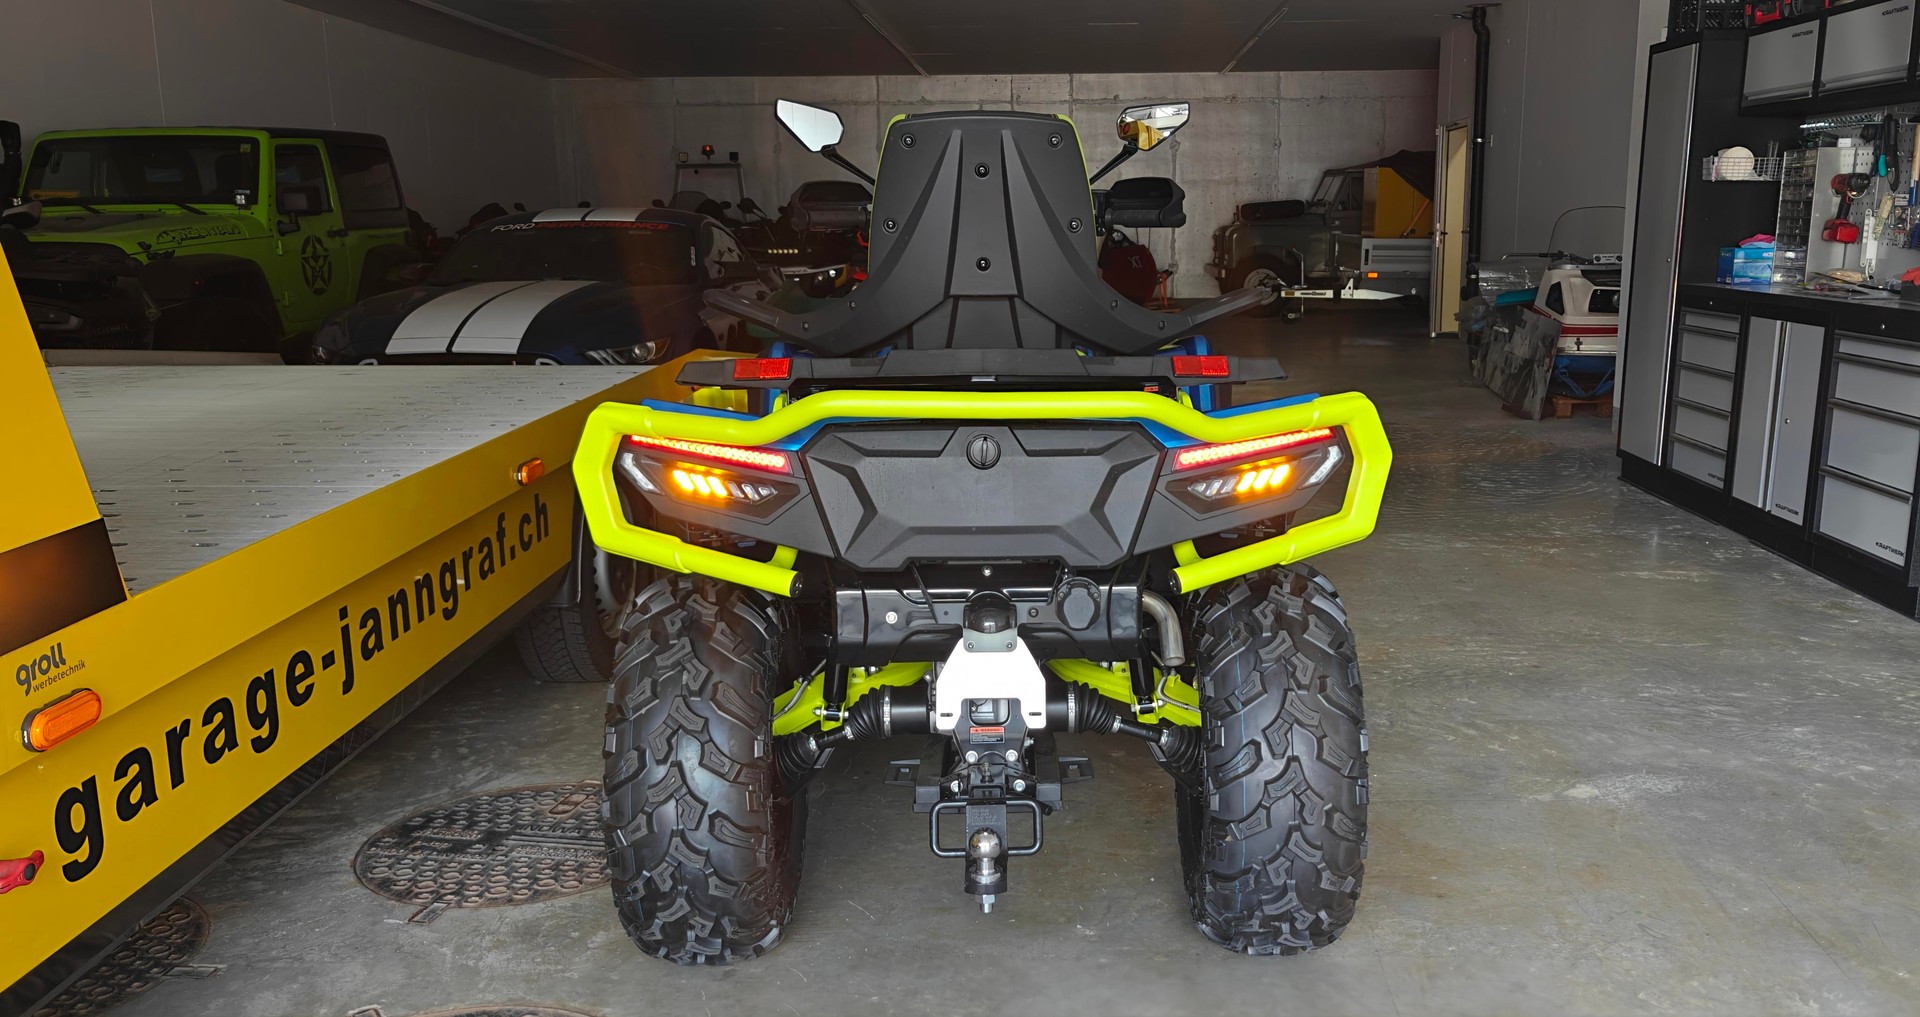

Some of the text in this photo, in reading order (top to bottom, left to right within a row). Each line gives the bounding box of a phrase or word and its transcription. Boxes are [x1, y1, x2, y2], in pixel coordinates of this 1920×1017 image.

[491, 220, 670, 233] FORD PERFORMANCE
[1875, 541, 1905, 558] KRAFTWERK
[16, 641, 67, 697] groll
[32, 659, 87, 694] werbetechnik
[54, 493, 550, 883] garage-janngraf.ch
